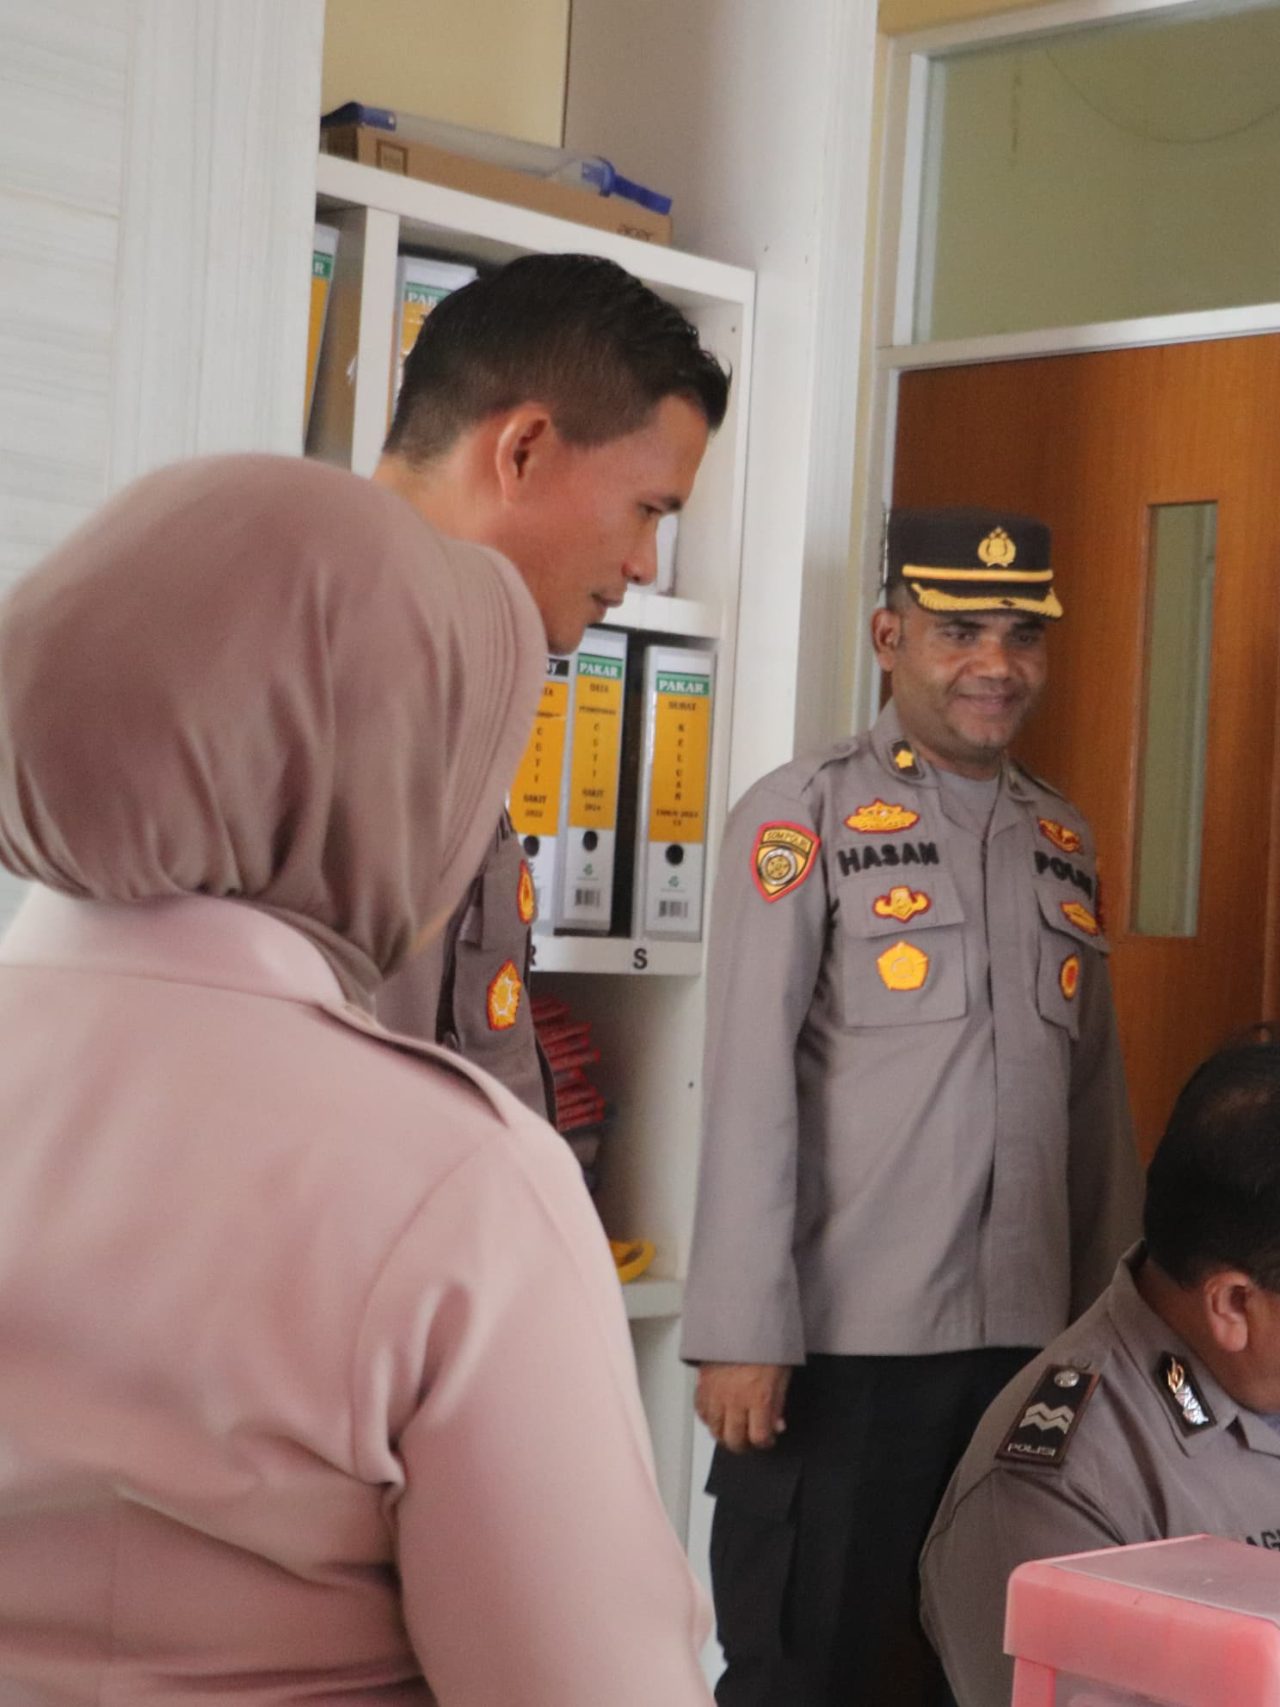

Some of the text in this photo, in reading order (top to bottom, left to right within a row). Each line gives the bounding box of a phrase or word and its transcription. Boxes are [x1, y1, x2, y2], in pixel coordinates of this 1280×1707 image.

[580, 661, 618, 678] PAKAR
[658, 679, 705, 693] PAKAR
[837, 842, 940, 877] HASAN
[632, 947, 649, 970] S
[1007, 1442, 1057, 1457] POLISI
